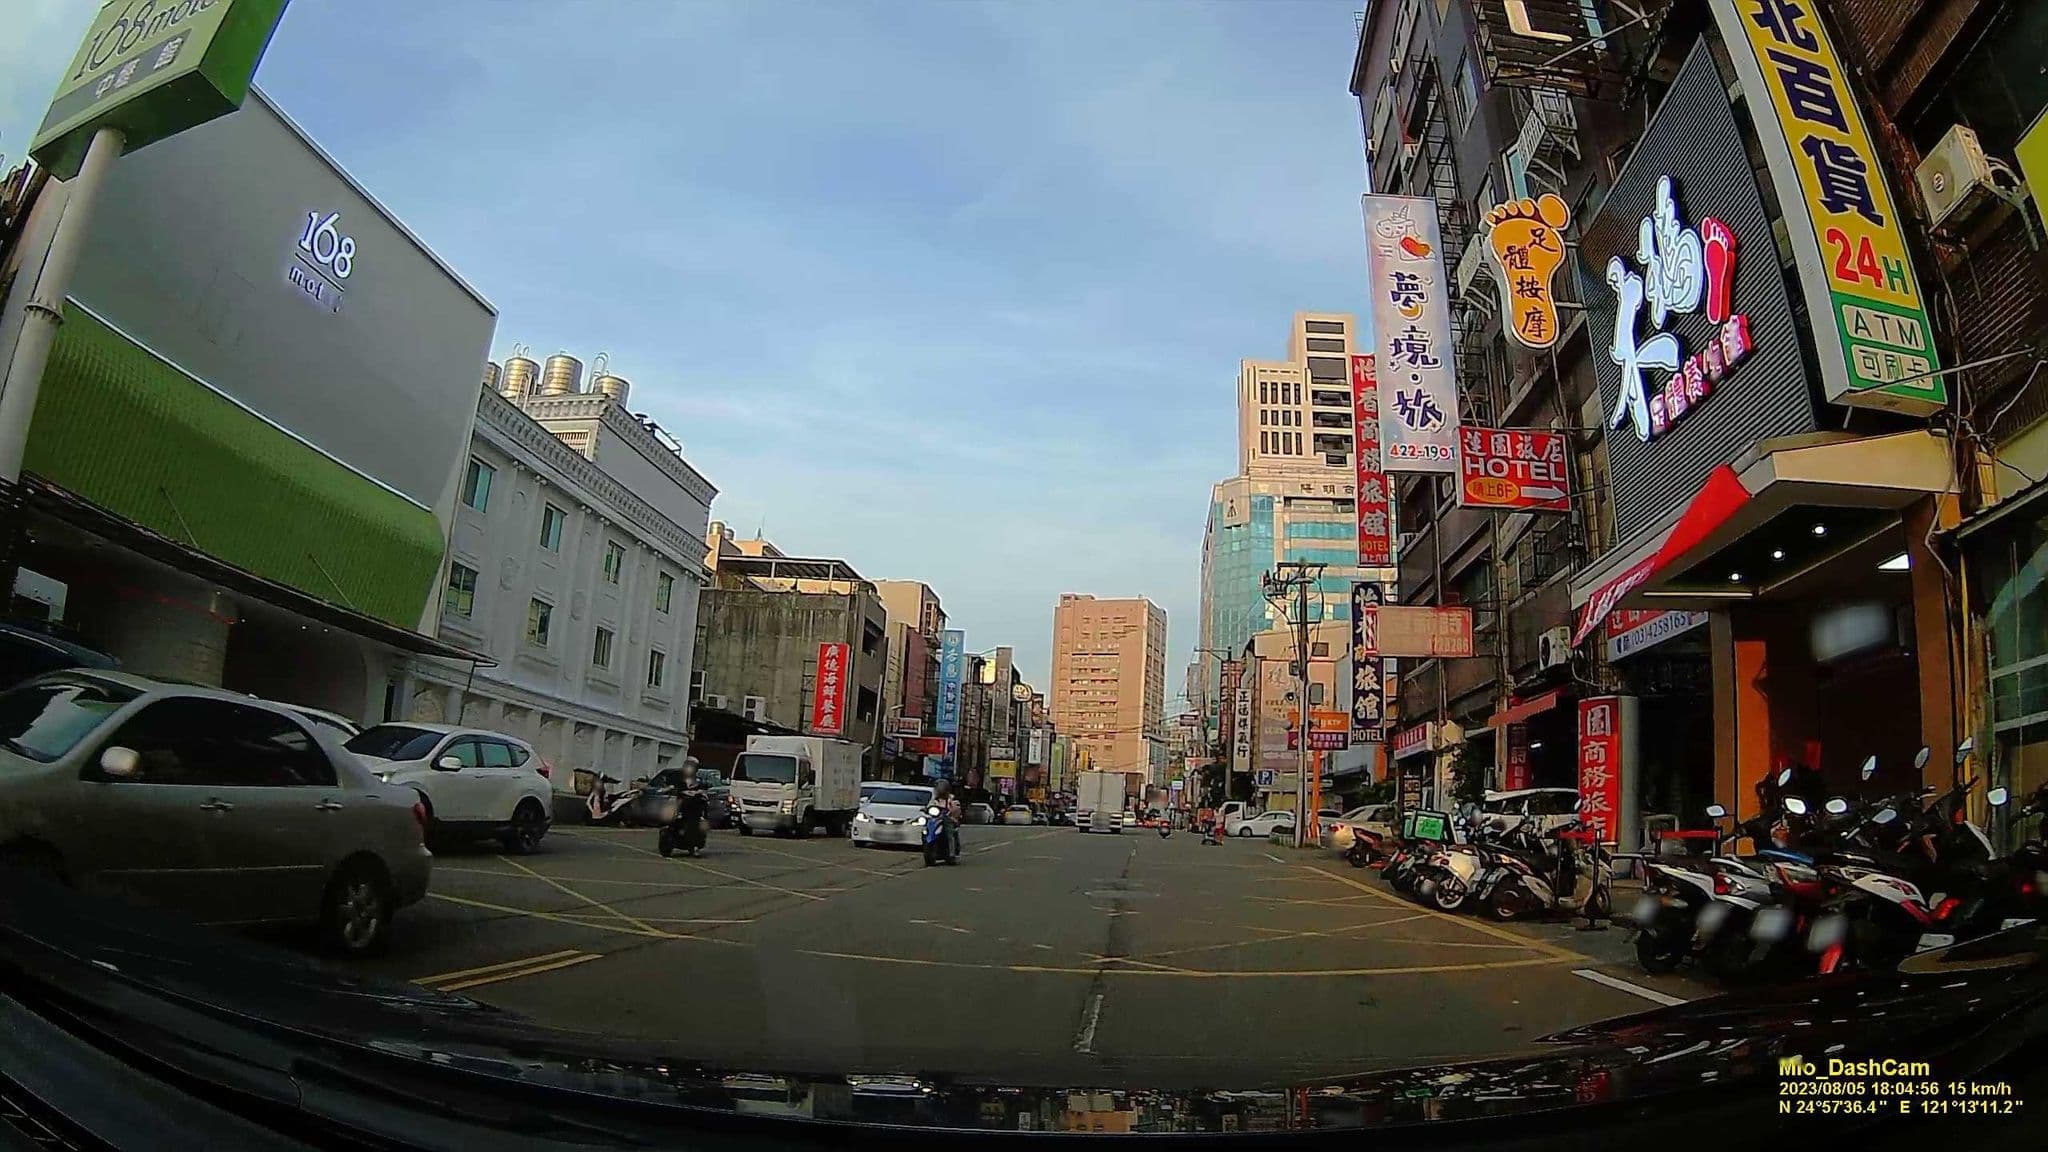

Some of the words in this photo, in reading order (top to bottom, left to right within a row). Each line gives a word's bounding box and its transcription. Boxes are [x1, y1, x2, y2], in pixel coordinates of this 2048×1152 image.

[298, 211, 357, 279] 168
[1826, 228, 1910, 297] 24H
[1853, 312, 1922, 349] ATM
[1389, 443, 1455, 461] 422-1901
[1465, 456, 1566, 482] HOTEL
[1361, 541, 1388, 551] HOTEL
[1352, 729, 1383, 742] HOTEL
[1262, 772, 1271, 783] P
